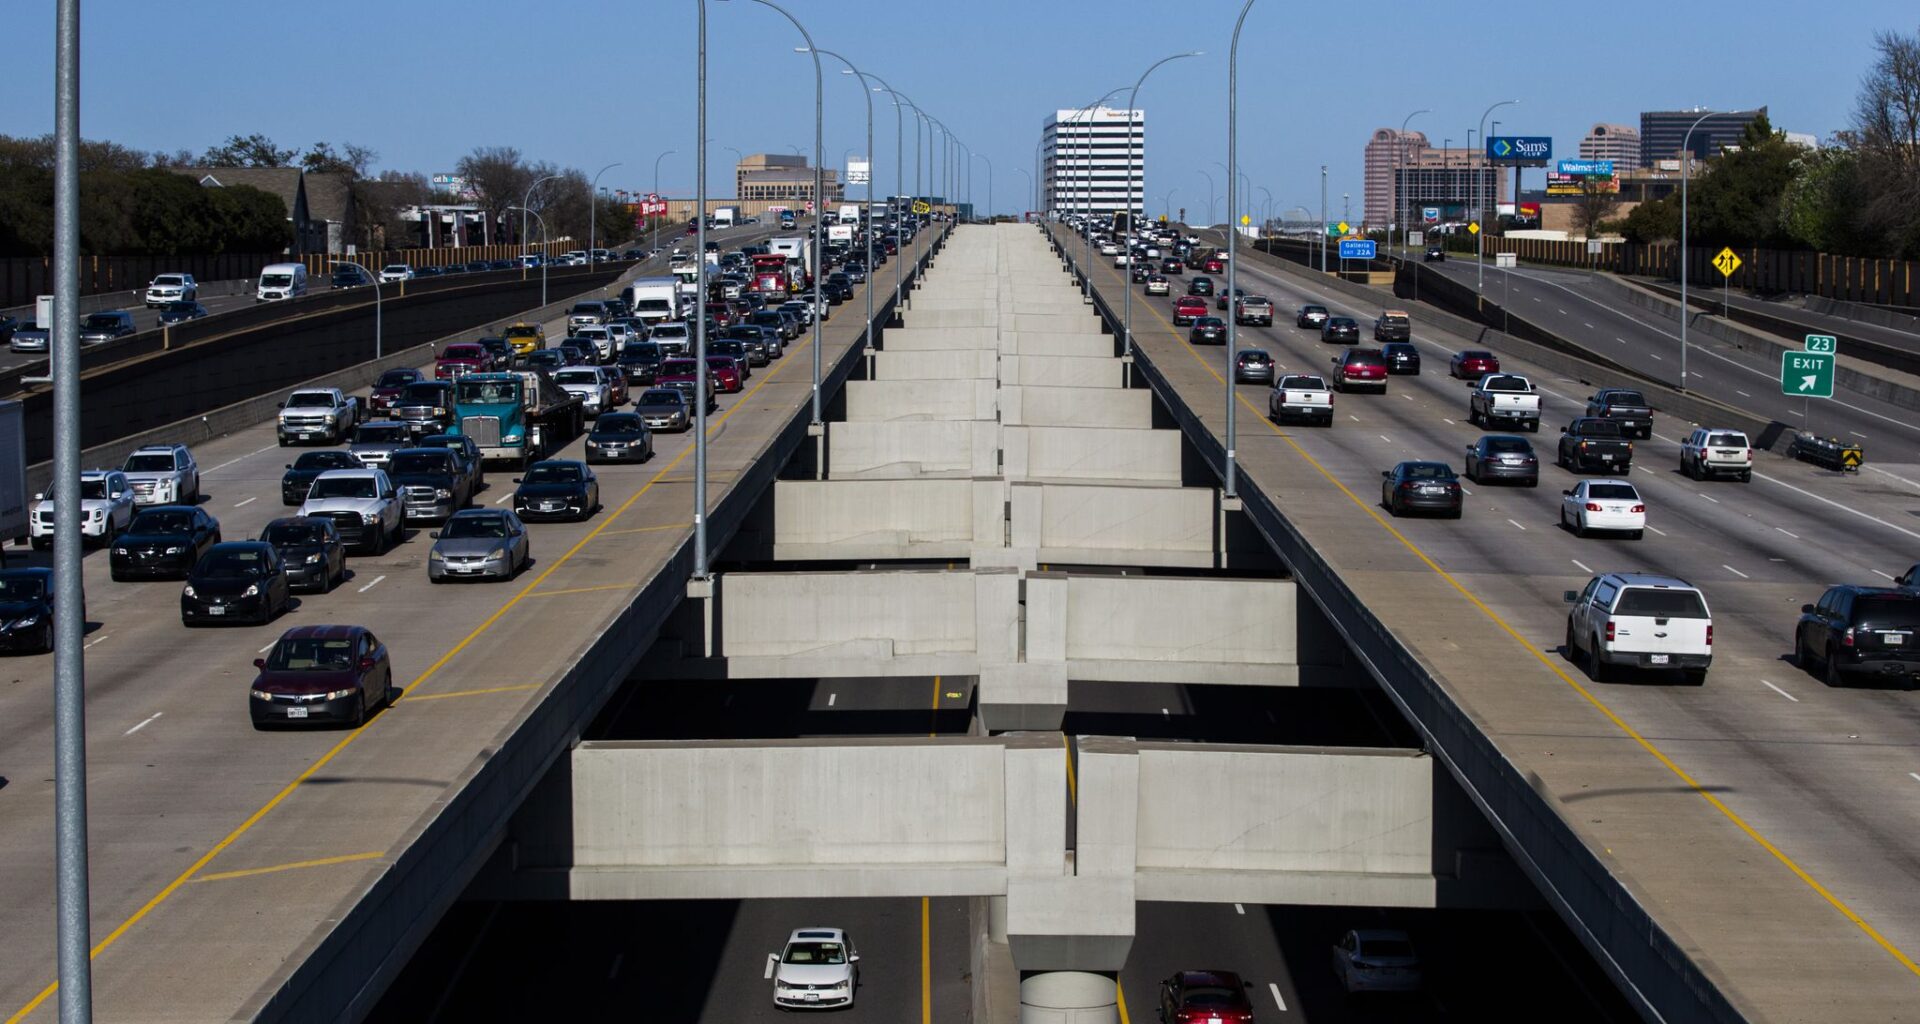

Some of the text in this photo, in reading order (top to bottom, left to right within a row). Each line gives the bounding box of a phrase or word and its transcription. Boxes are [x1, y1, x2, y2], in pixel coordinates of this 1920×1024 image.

[1515, 139, 1548, 152] Sam's
[1561, 163, 1598, 172] Walmart
[1811, 337, 1830, 351] 23
[1793, 357, 1824, 370] EXIT
